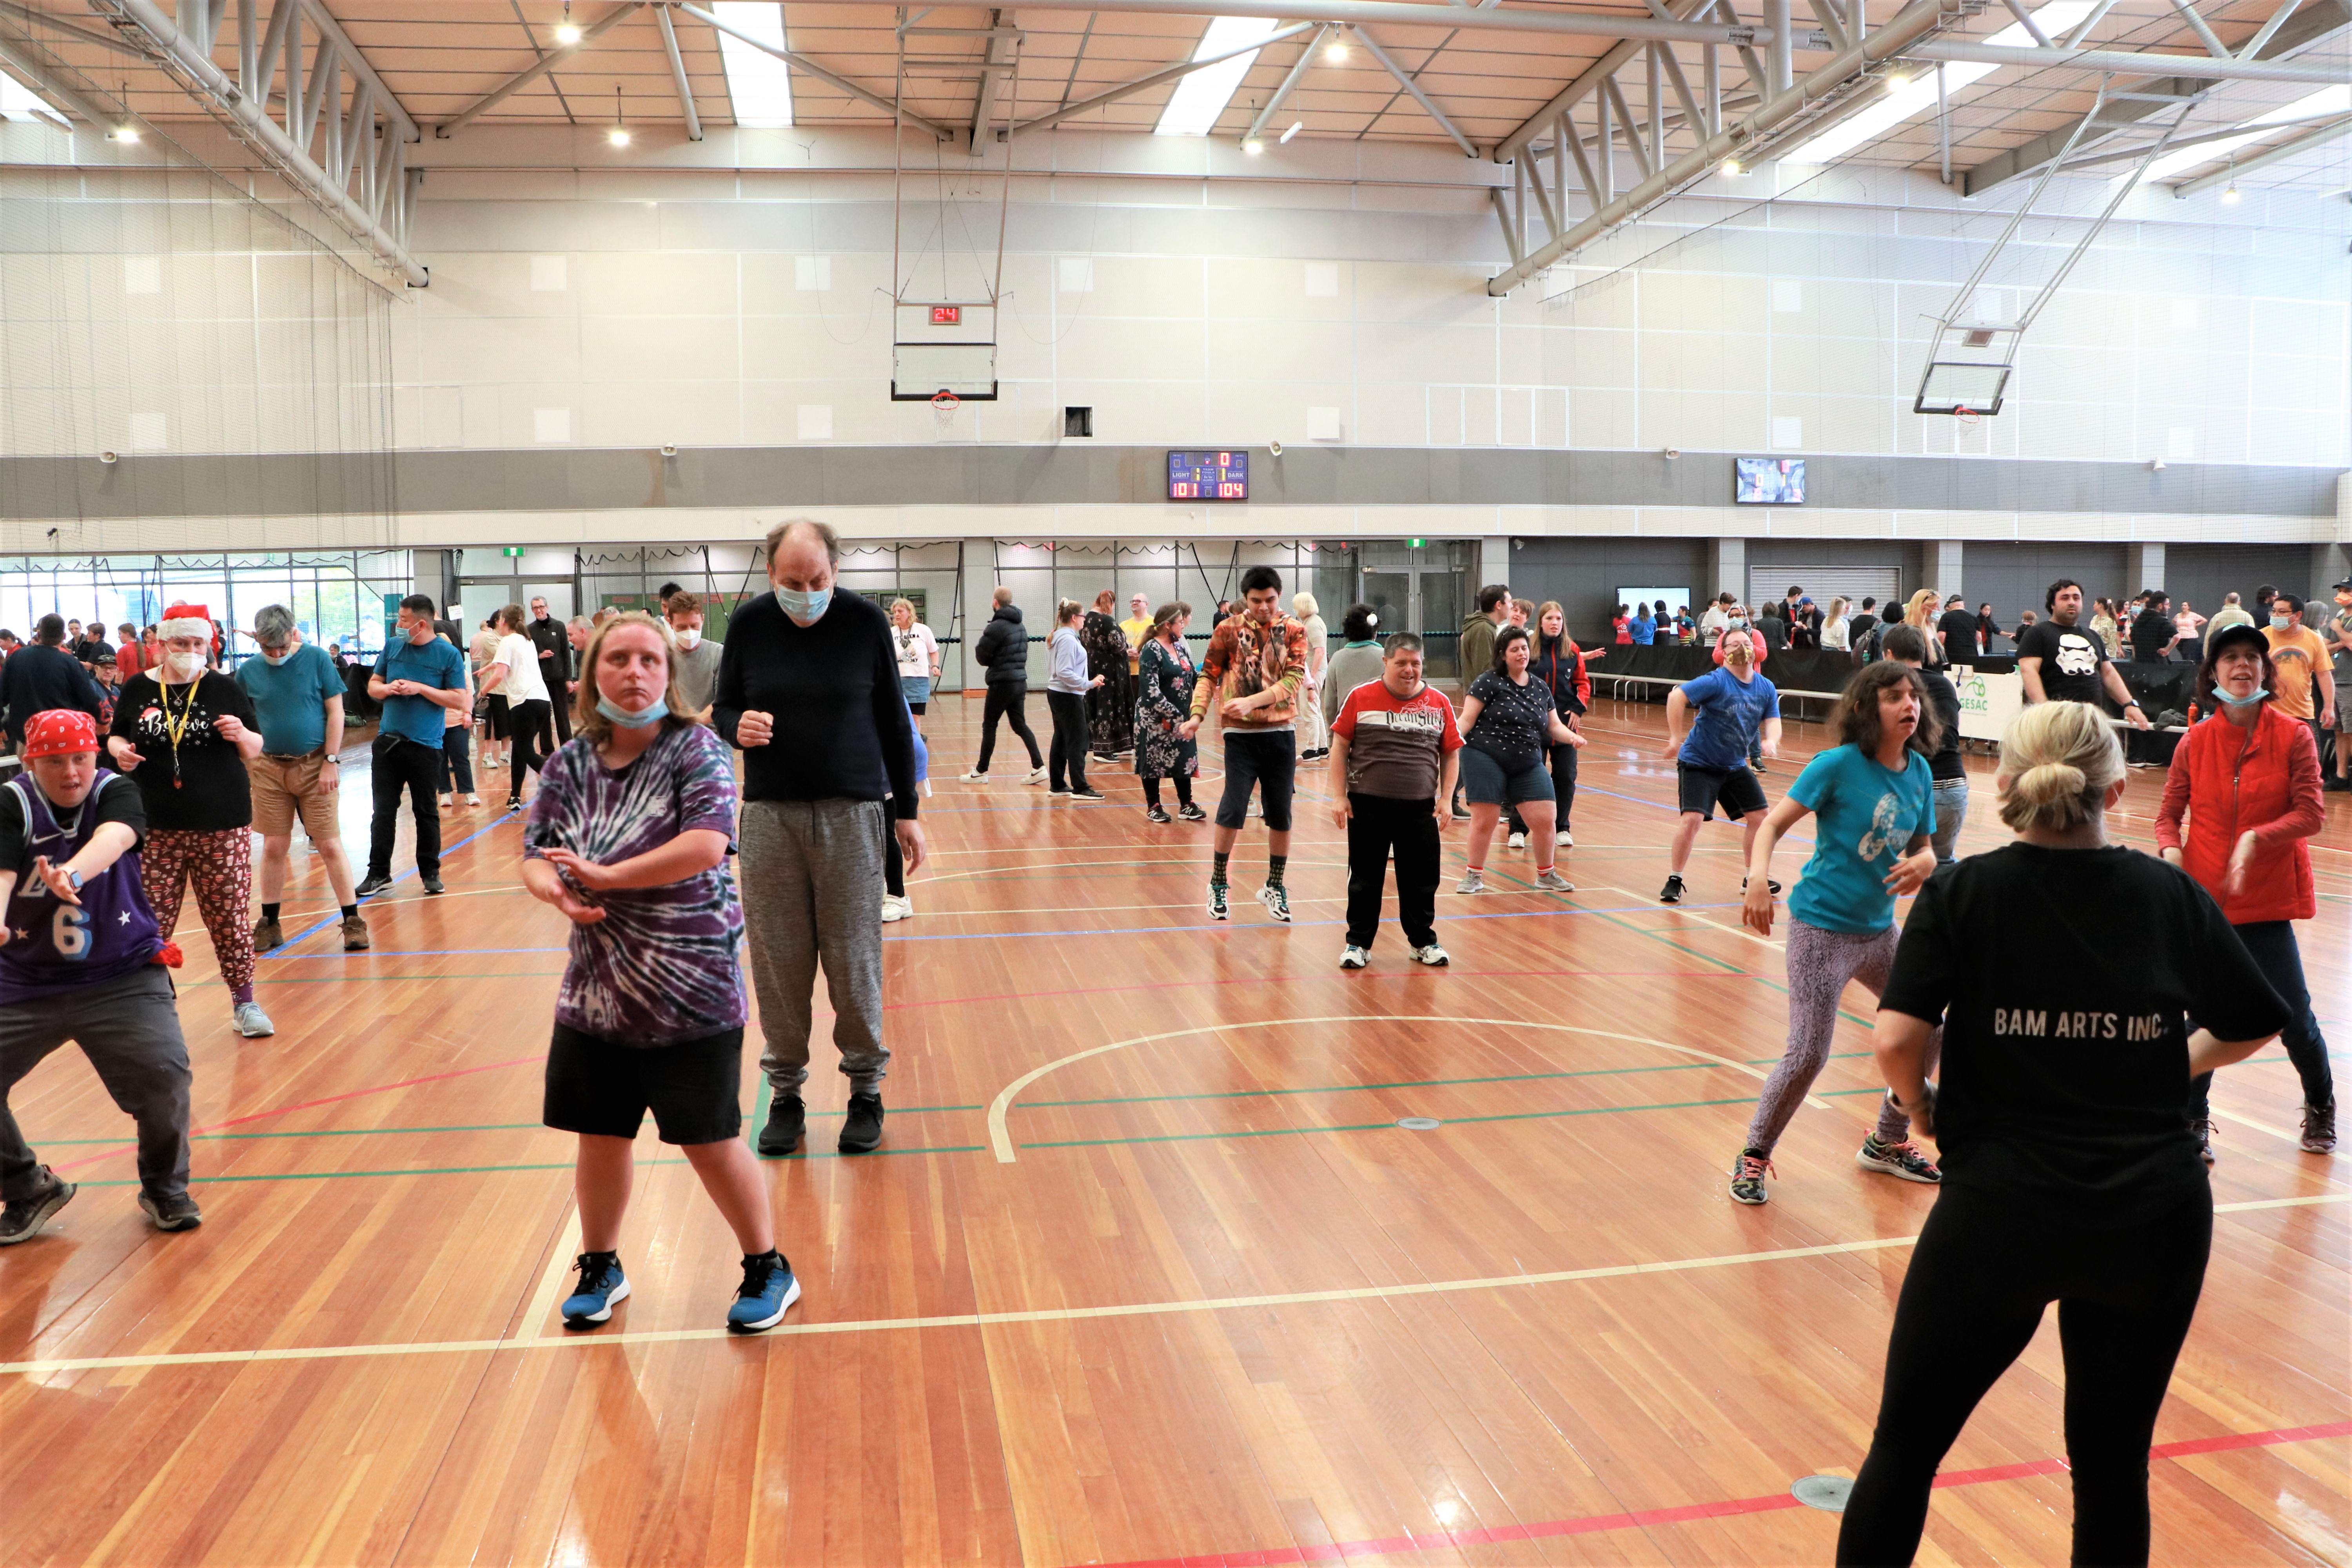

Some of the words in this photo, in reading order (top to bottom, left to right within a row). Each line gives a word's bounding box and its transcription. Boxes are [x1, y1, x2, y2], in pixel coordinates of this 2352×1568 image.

[935, 308, 955, 319] 24
[1220, 452, 1229, 466] 0
[1222, 468, 1225, 481] 1
[1173, 483, 1198, 497] 101
[1219, 483, 1243, 497] 104
[1959, 698, 1987, 711] GESAC
[53, 904, 91, 959] 6
[1995, 1008, 2047, 1036] BAM
[2054, 1011, 2118, 1039] ARTS
